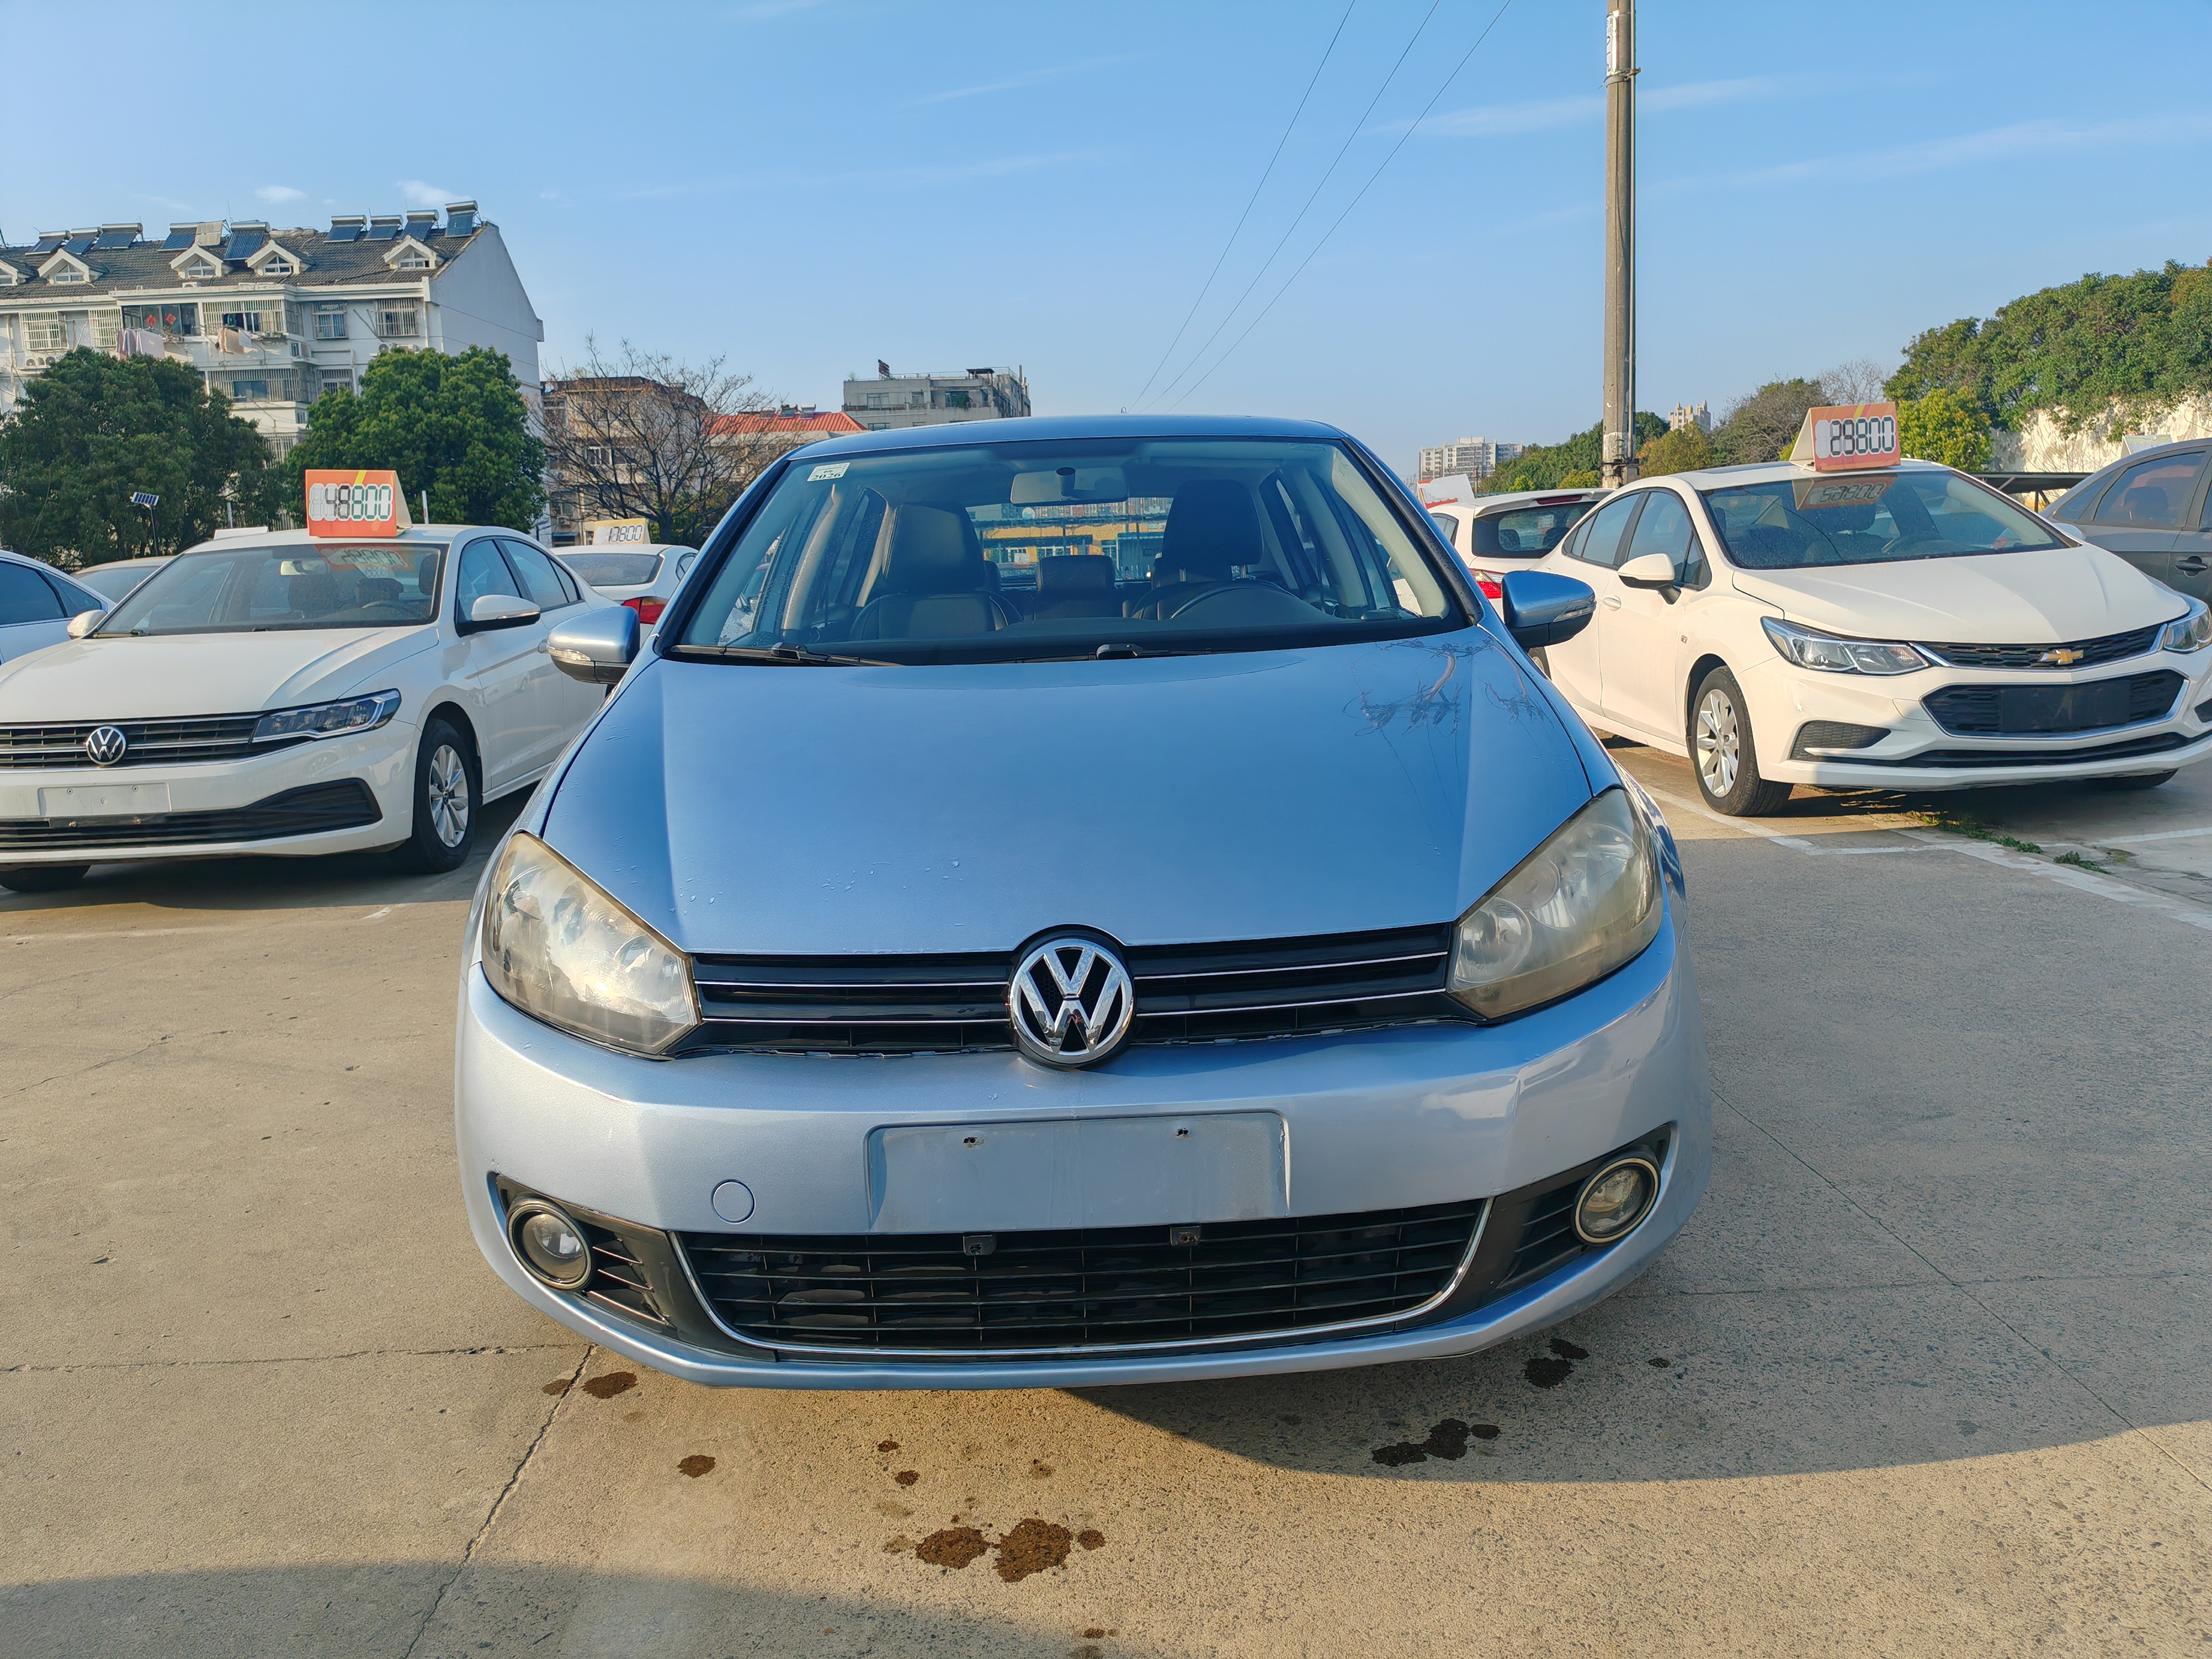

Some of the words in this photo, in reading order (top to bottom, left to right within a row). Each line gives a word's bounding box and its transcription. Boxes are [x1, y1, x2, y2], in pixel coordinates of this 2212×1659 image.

[1830, 416, 1894, 456] 29800
[324, 484, 391, 520] 48800
[1010, 938, 1133, 1064] VW
